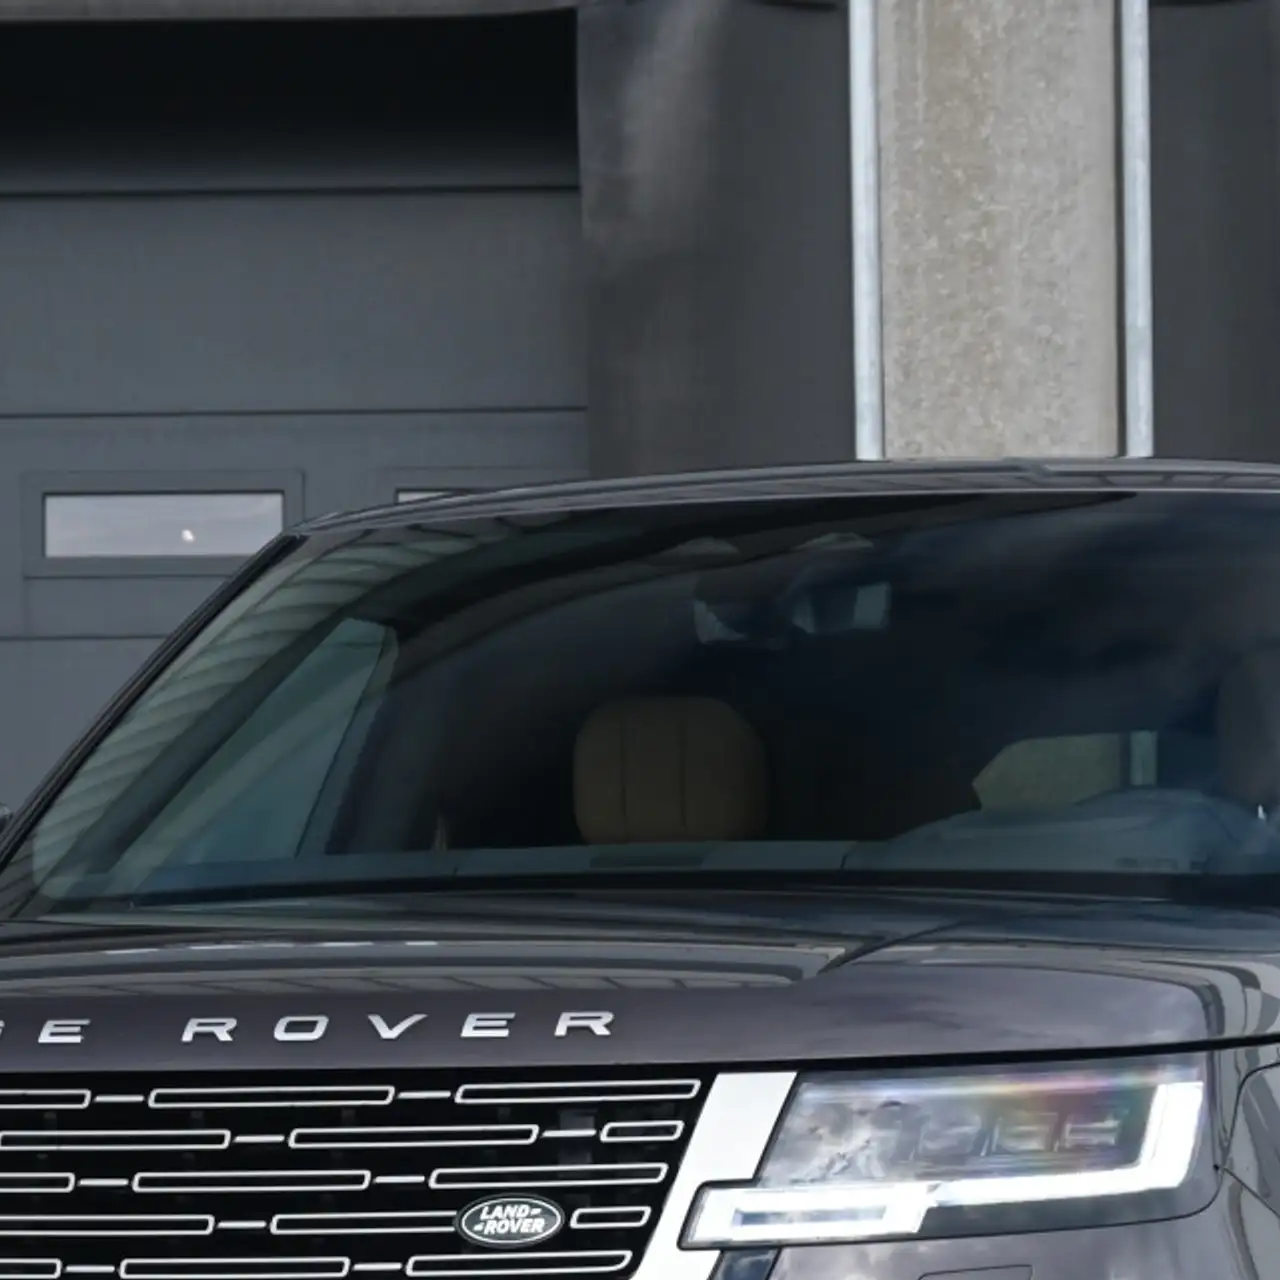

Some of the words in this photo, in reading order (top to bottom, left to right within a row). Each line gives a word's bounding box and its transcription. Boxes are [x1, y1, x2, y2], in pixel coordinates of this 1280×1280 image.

[179, 1010, 616, 1043] ROVER
[479, 1204, 531, 1221] LAND
[483, 1217, 546, 1236] ROVER
